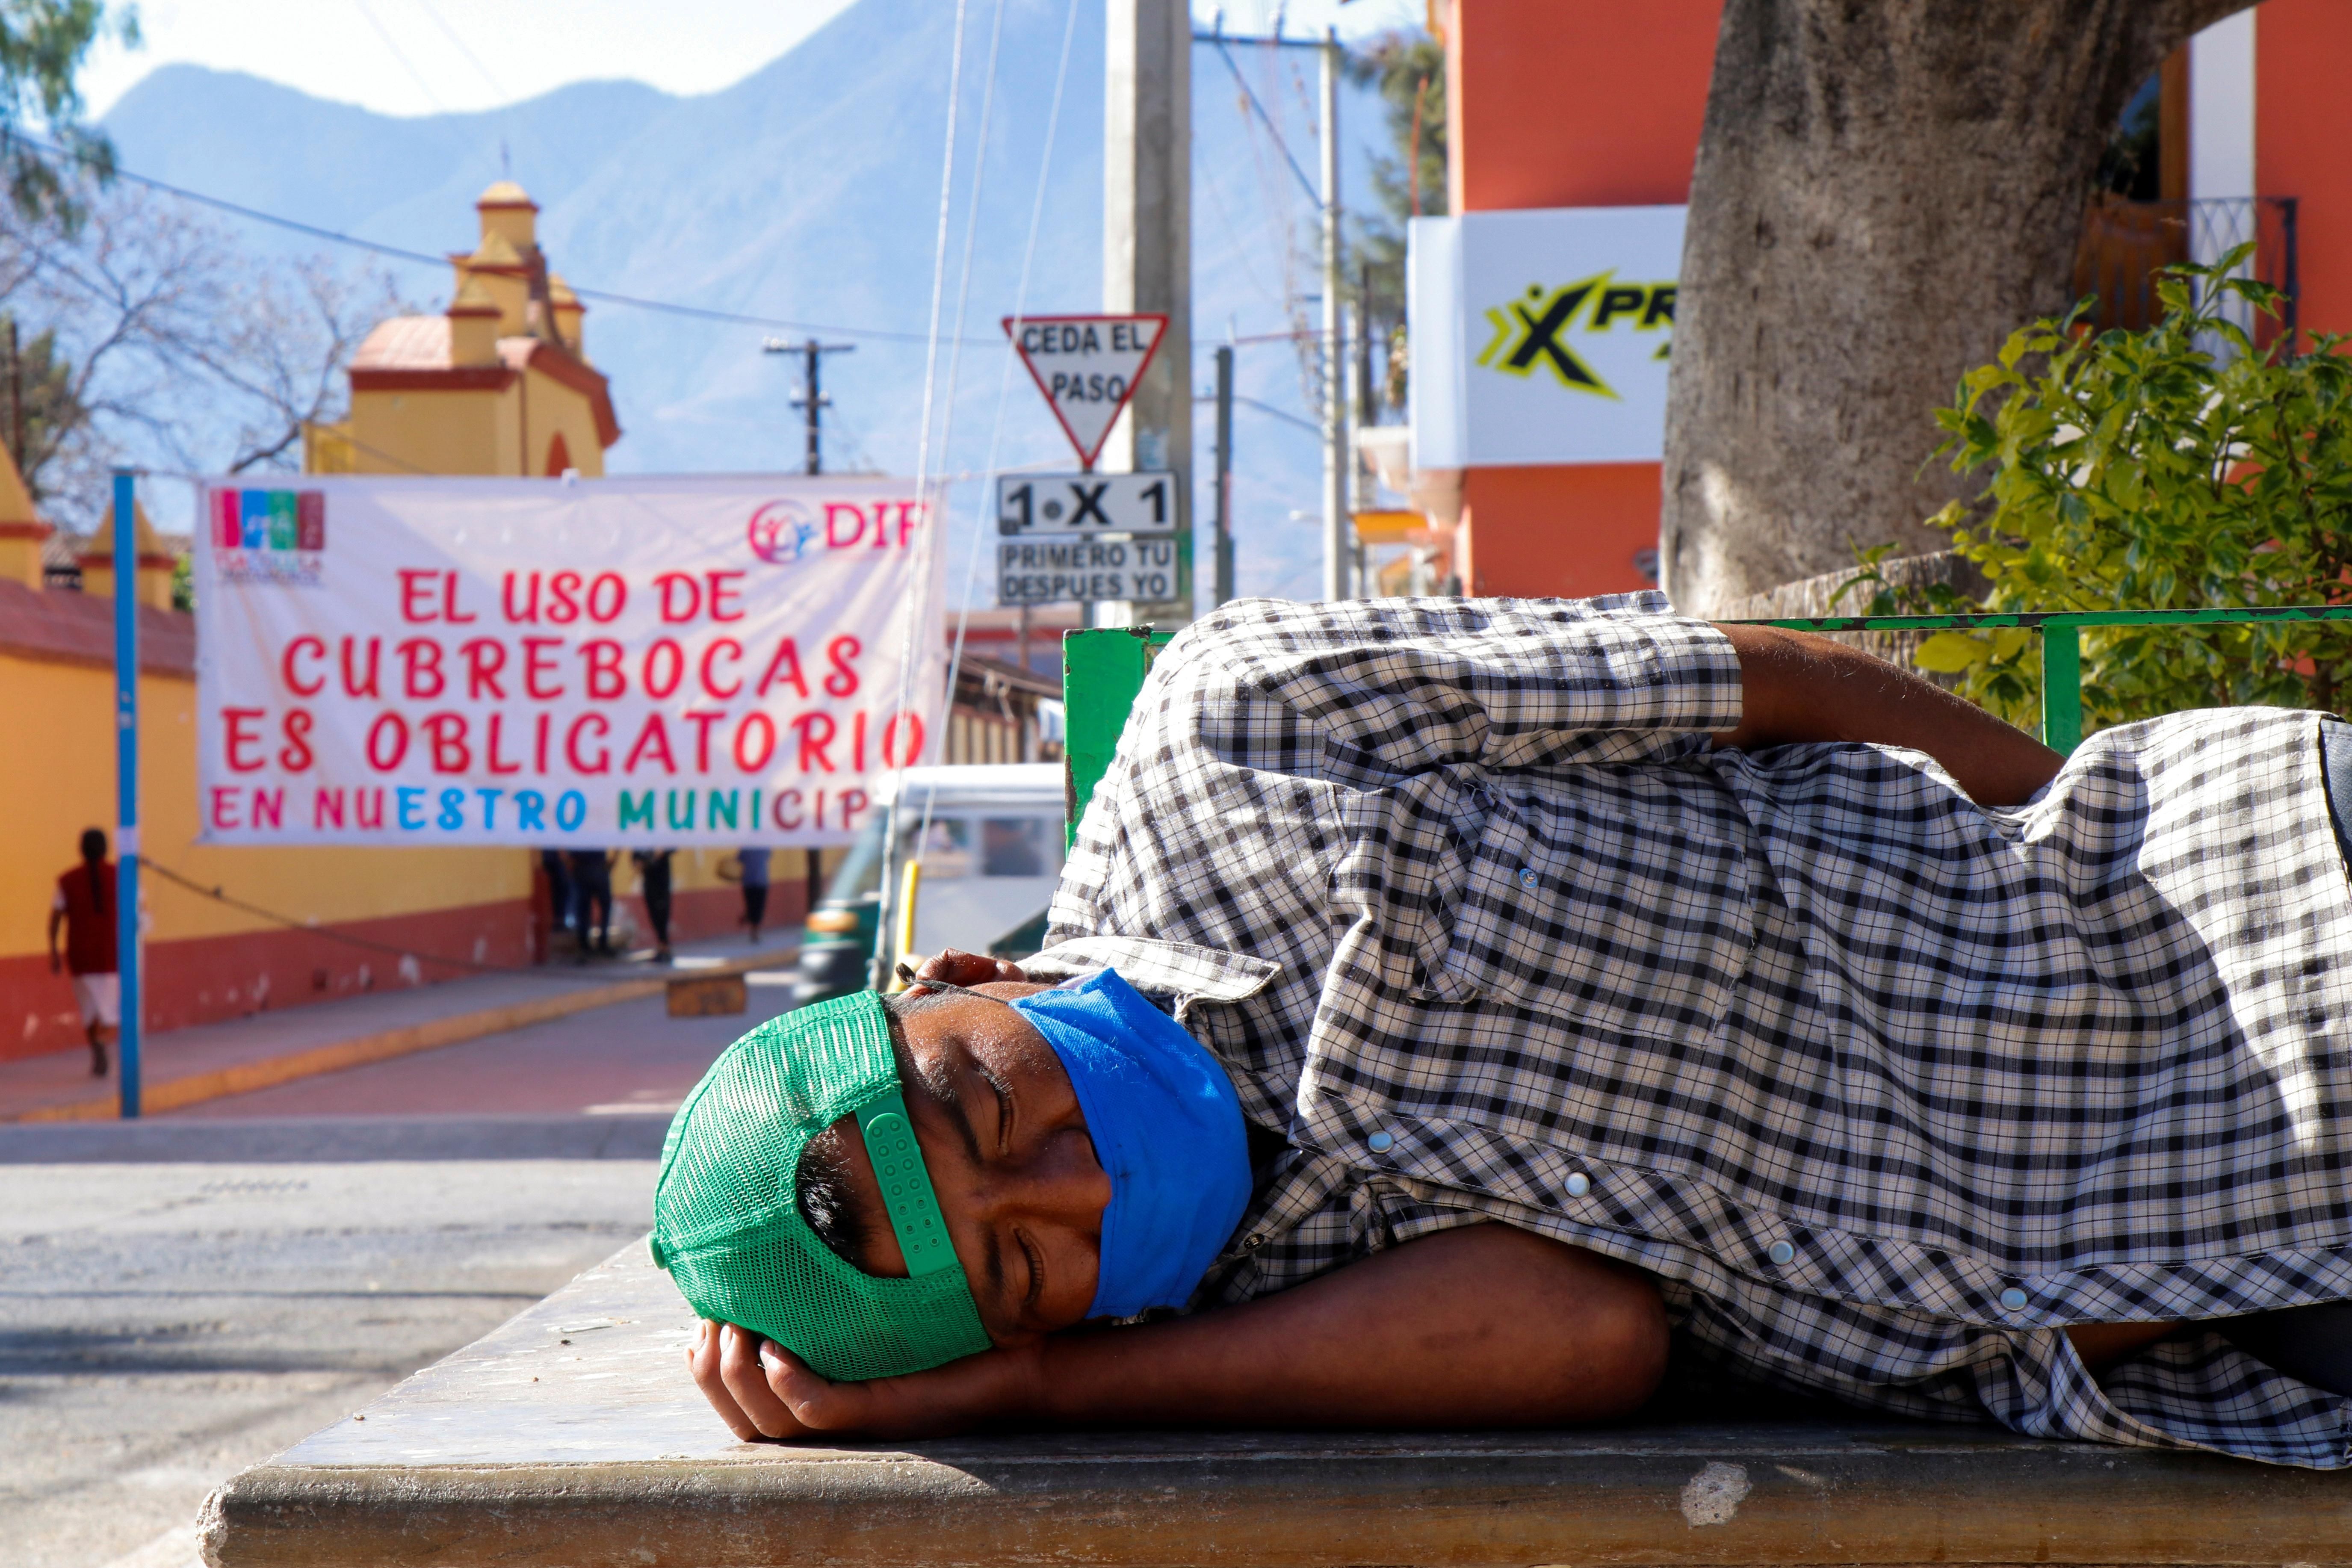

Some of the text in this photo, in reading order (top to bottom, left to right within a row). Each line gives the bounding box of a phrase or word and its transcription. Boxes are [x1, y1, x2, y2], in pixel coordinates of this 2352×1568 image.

[1022, 325, 1147, 353] CEDA EL
[1052, 372, 1126, 402] PASO
[822, 502, 928, 549] DIF
[1008, 481, 1165, 526] 1 X 1
[1005, 544, 1171, 567] PRIMERO TU
[397, 569, 748, 623] EL USO DE
[1005, 574, 1167, 598] DESPUES YO
[281, 635, 862, 700] CUBREBOCAS
[221, 708, 927, 776] ES OBLIGATORIO
[210, 787, 284, 829] EN
[314, 787, 586, 831] NUESTRO
